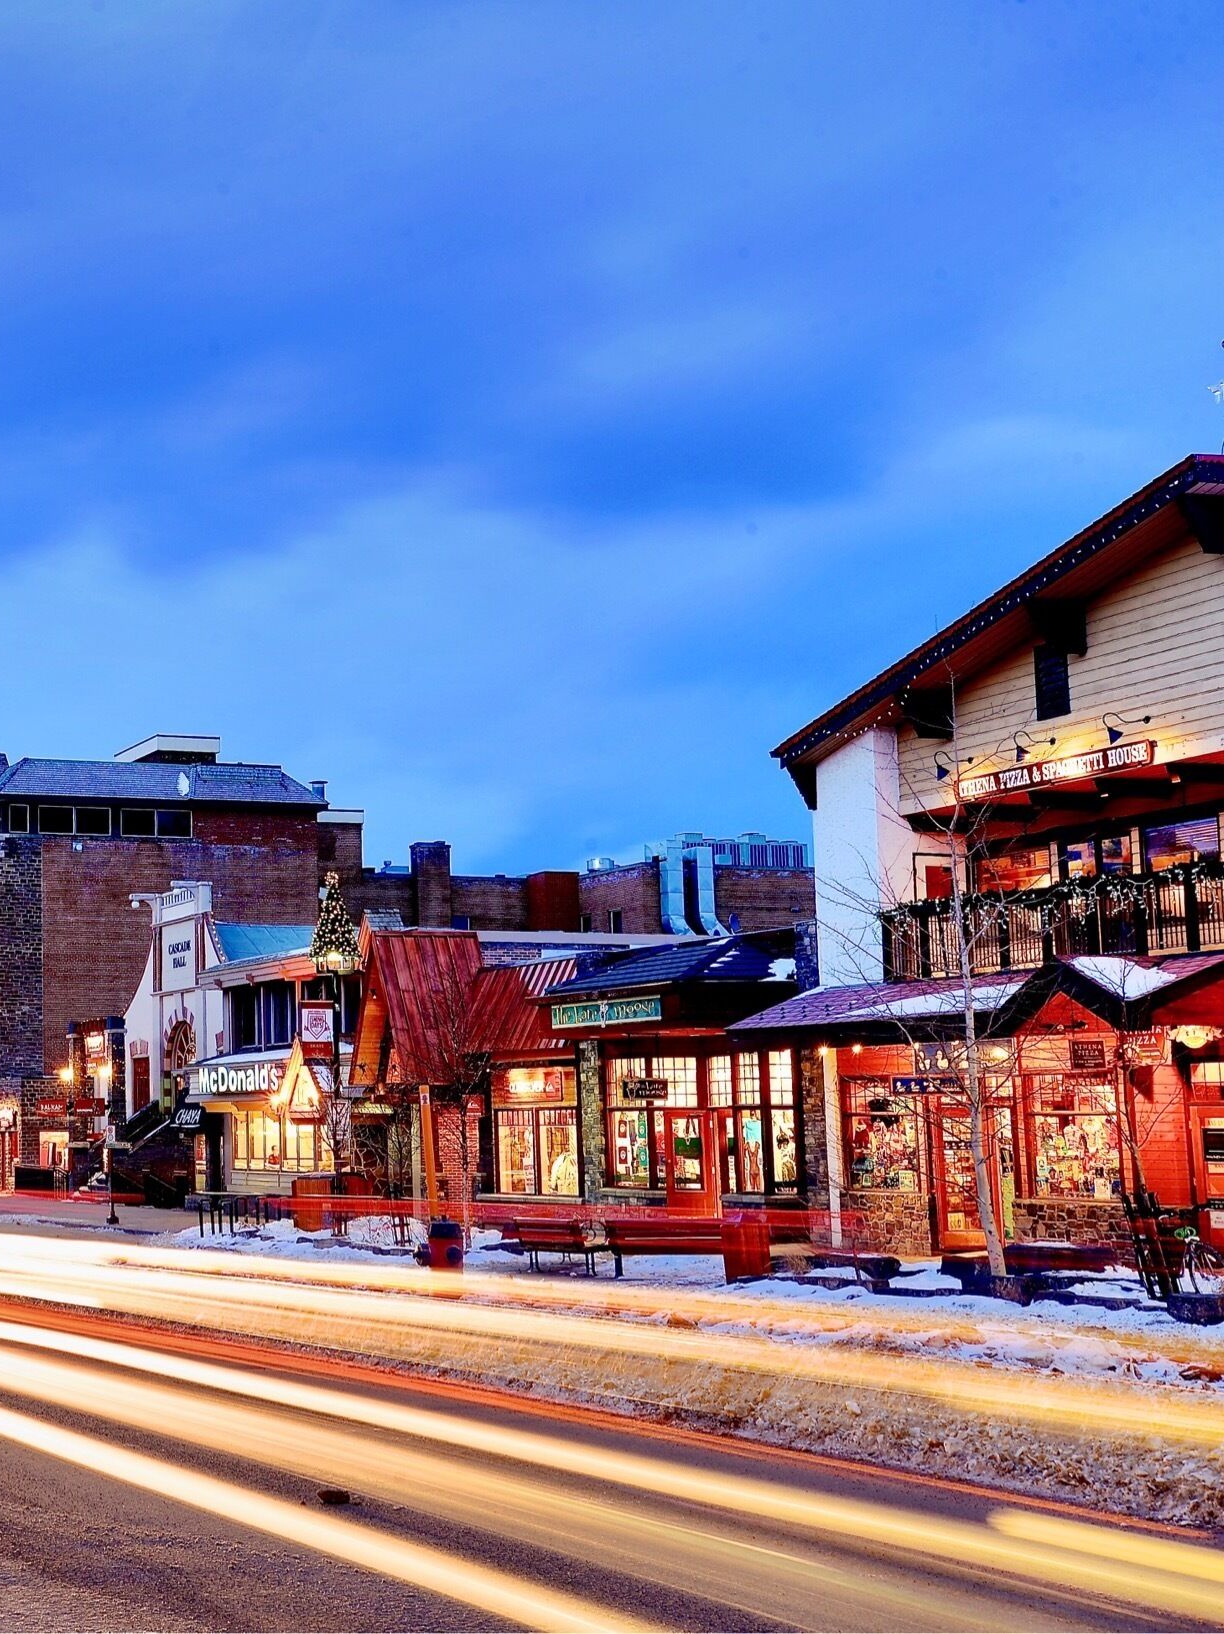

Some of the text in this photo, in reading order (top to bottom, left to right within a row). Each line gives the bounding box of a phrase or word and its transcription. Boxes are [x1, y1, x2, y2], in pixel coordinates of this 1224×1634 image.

[999, 768, 1031, 790] PIZZA
[1032, 767, 1041, 783] &
[1042, 753, 1104, 782] SPAETTI
[1107, 743, 1148, 768] HOUSE
[168, 940, 191, 955] CASCADE
[172, 956, 187, 969] HALL
[198, 1063, 279, 1093] McDonald's
[175, 1108, 202, 1124] CHAYA
